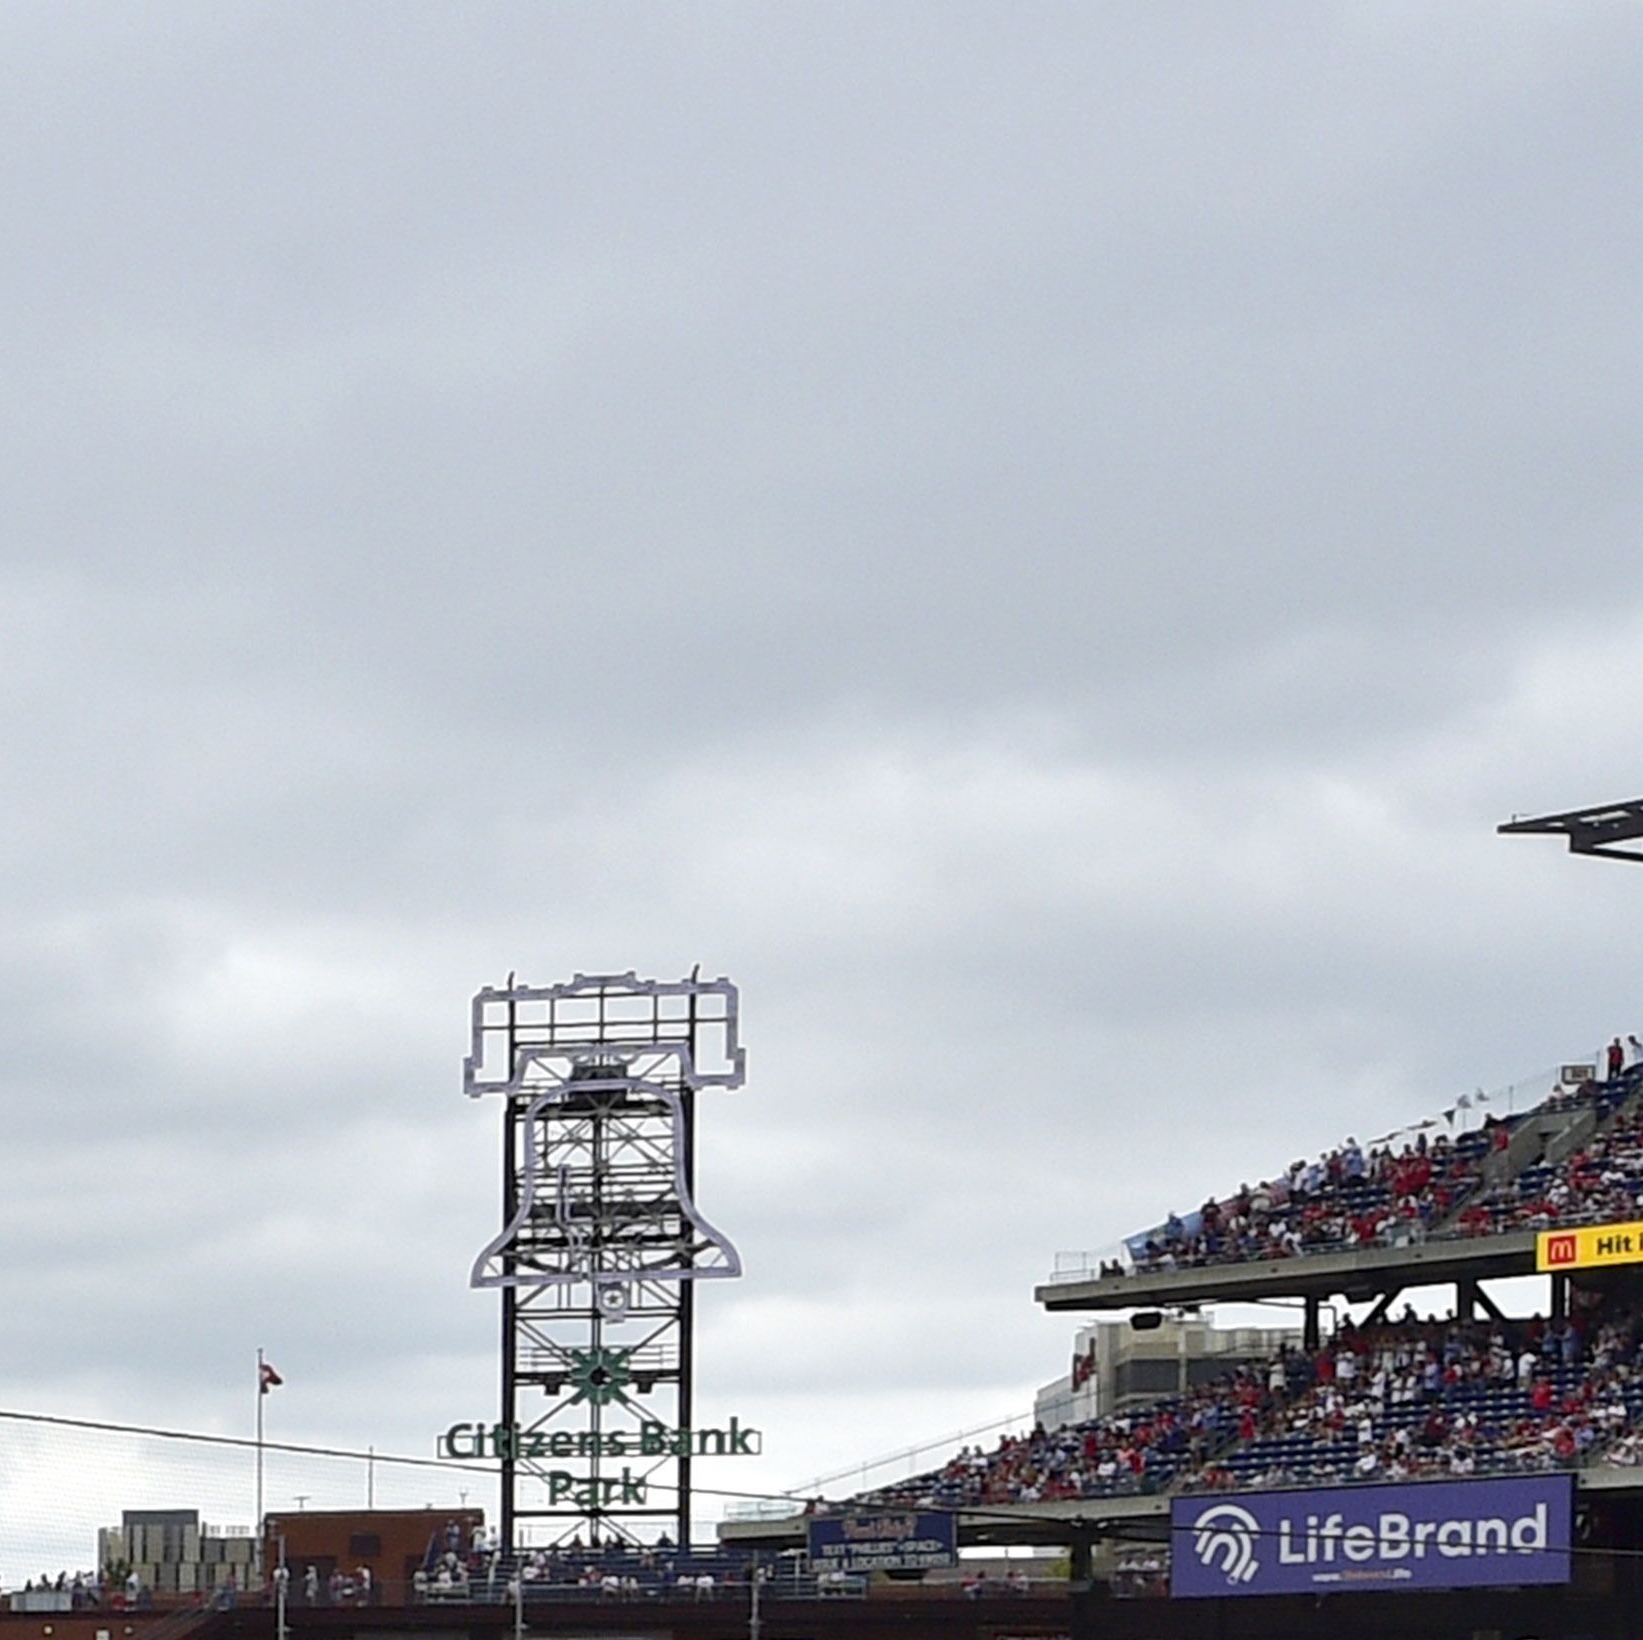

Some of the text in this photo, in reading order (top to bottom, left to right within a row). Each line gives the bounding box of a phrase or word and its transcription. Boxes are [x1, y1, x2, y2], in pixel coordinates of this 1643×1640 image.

[1596, 1235, 1632, 1256] Hit
[445, 1416, 753, 1460] Citizens Bank
[548, 1467, 648, 1506] Park
[1279, 1502, 1547, 1565] LifeBrand
